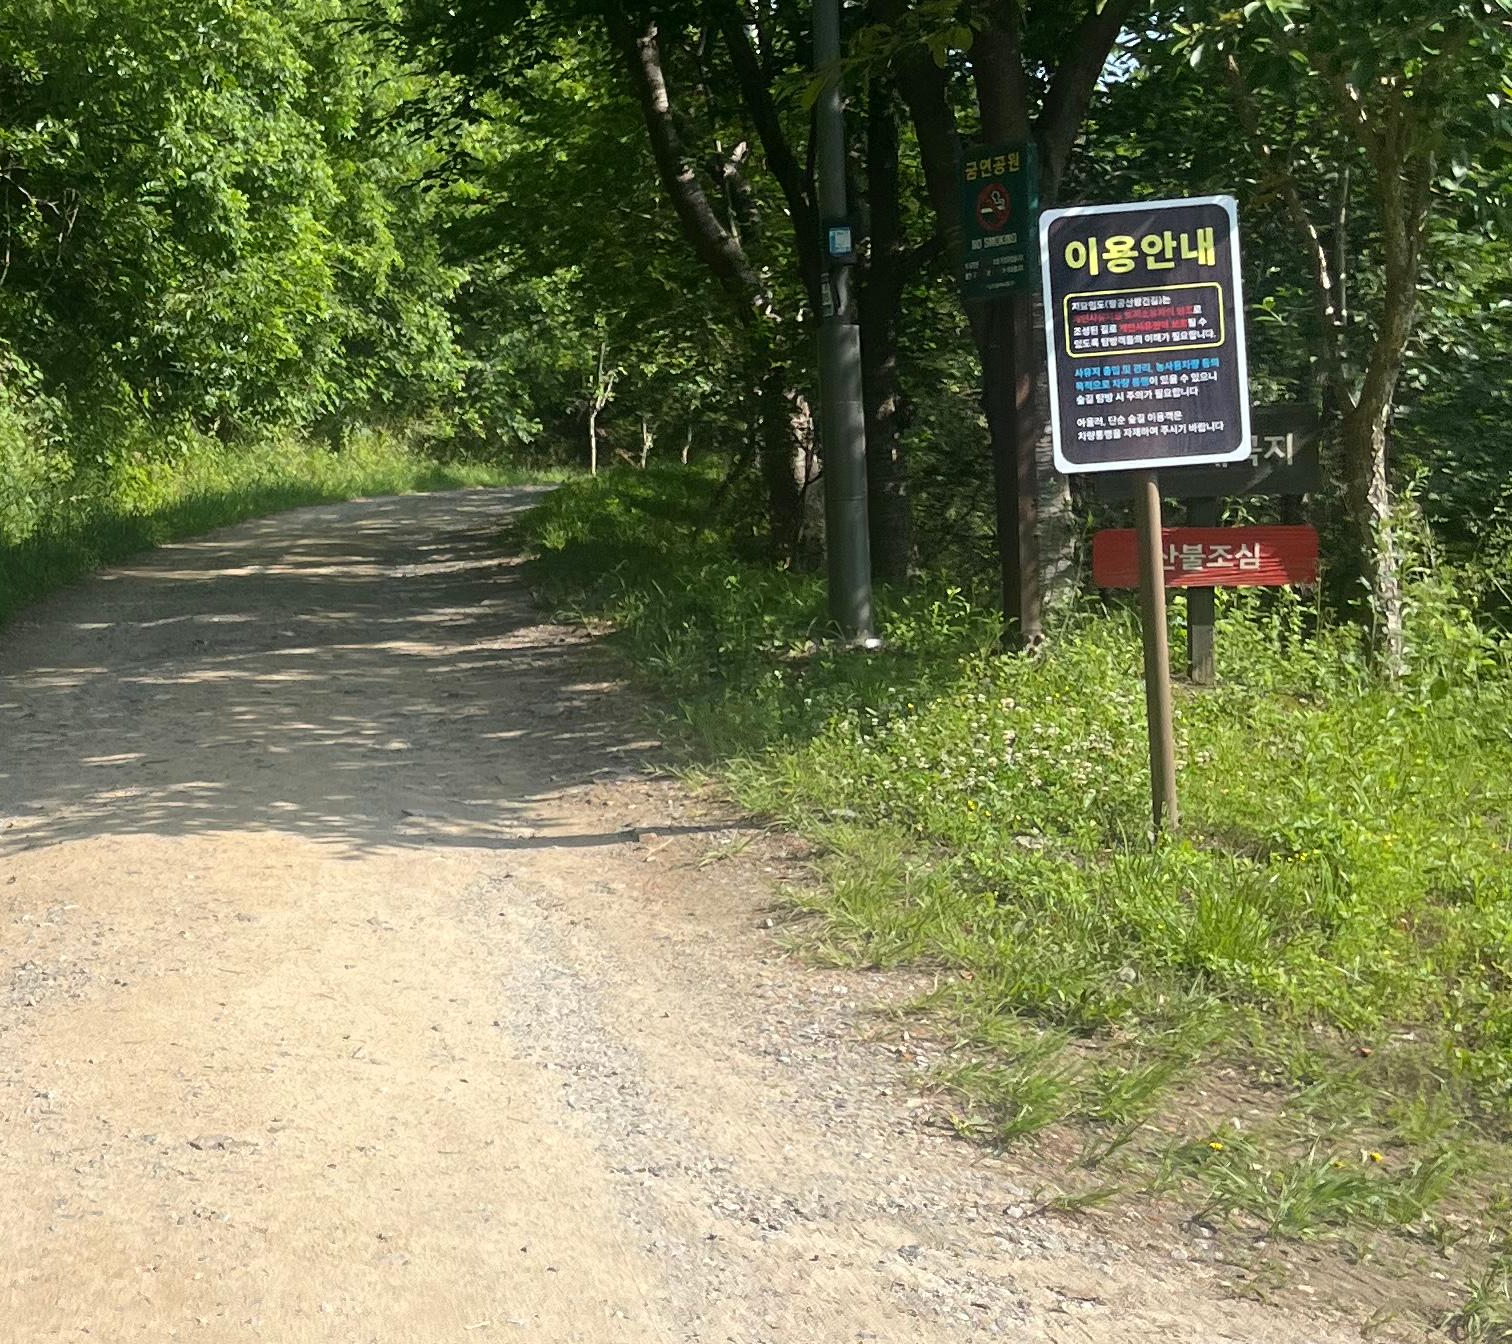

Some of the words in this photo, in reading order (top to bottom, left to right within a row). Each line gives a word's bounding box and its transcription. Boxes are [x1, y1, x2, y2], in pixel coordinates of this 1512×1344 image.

[965, 152, 1020, 181] 금연공원
[1064, 226, 1216, 276] 이용안내
[1180, 373, 1189, 384] 수
[1115, 392, 1125, 402] 시
